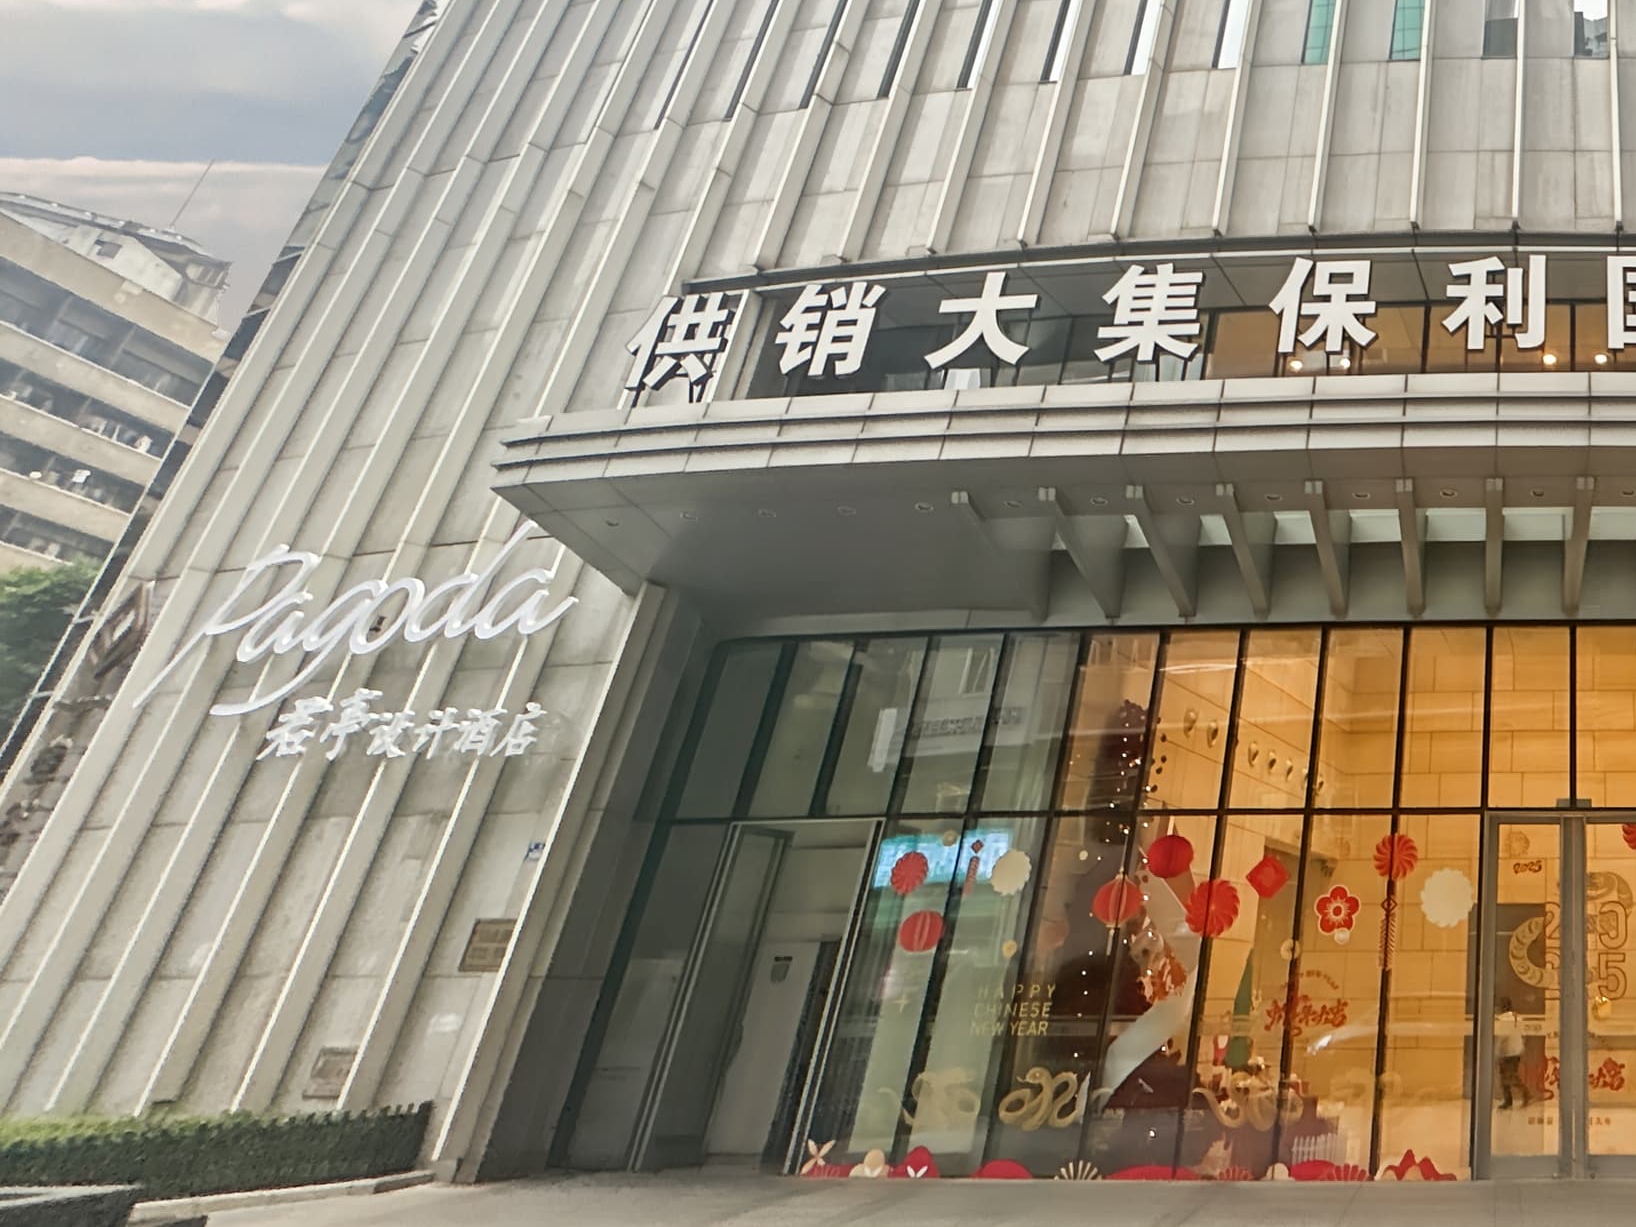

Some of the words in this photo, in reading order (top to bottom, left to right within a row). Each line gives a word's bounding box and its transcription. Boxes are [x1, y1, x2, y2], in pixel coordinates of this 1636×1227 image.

[132, 519, 579, 716] Pagoda
[256, 687, 548, 761] 君亭设计酒店
[1009, 1021, 1049, 1037] YEAR
